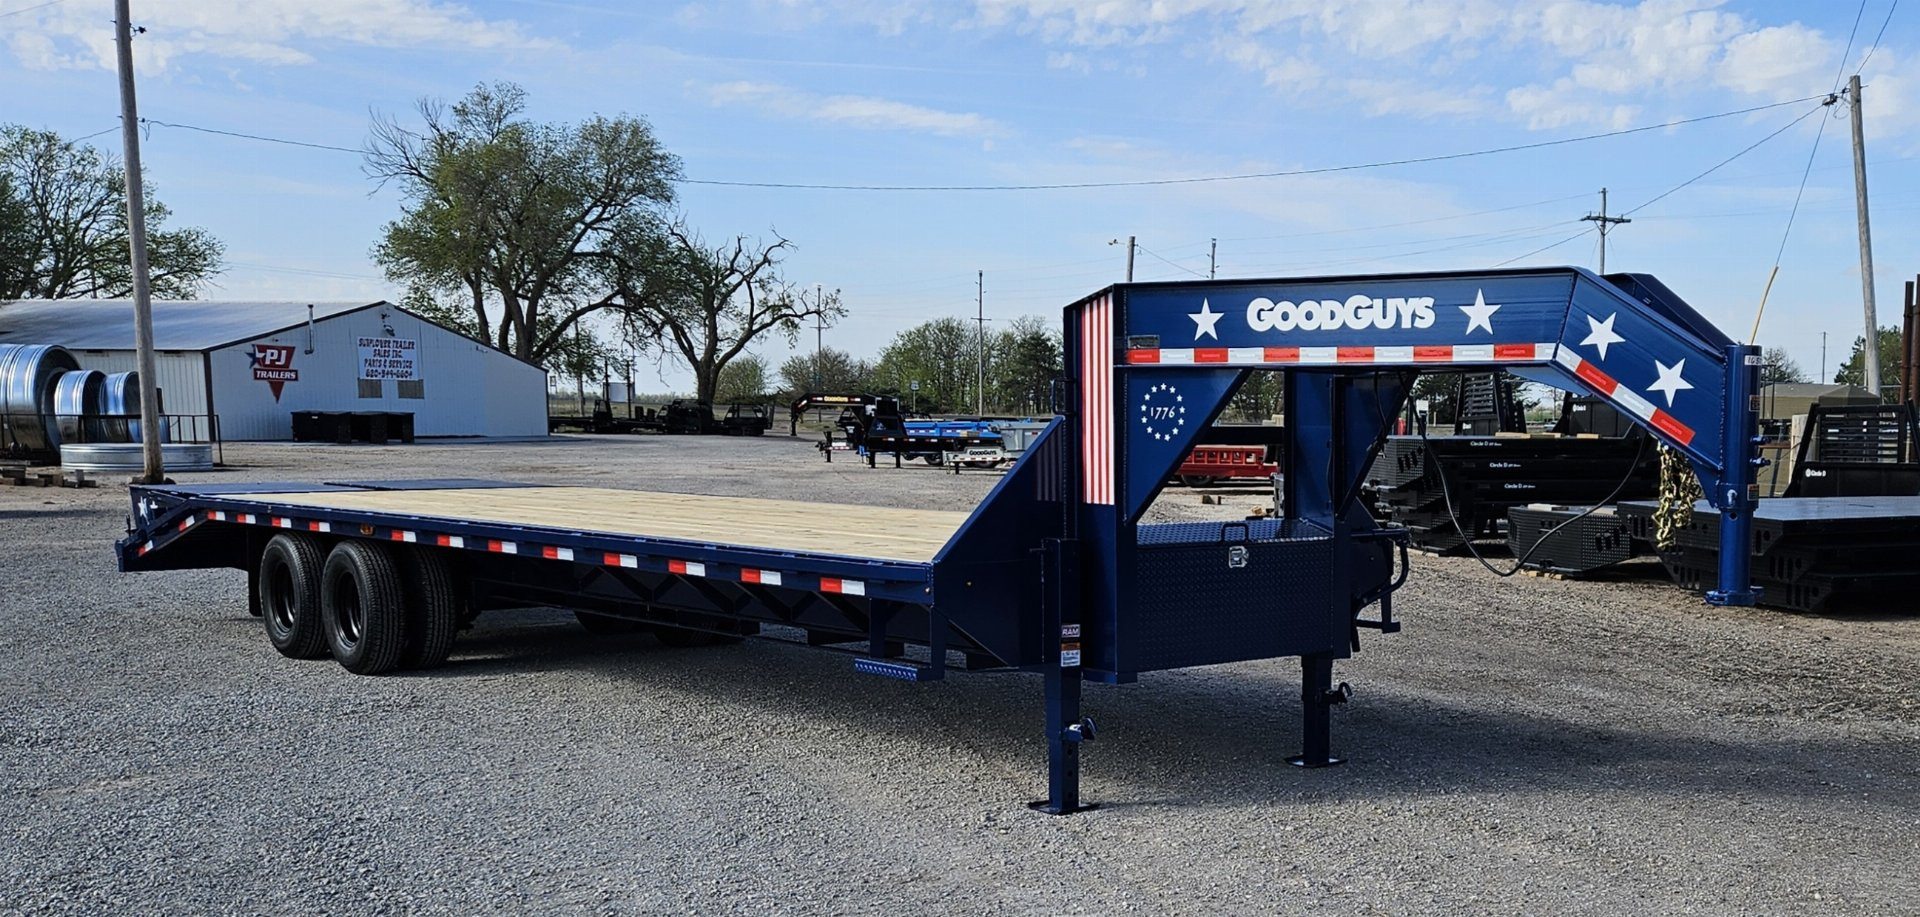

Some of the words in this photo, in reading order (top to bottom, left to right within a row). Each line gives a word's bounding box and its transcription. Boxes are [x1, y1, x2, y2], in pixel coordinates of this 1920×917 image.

[1247, 294, 1436, 332] GOODGUYS
[392, 340, 415, 349] TRAILER
[265, 349, 287, 365] PJ
[373, 348, 390, 358] SALES
[364, 358, 382, 368] PARTS
[389, 360, 413, 369] SERVICE
[256, 370, 297, 379] TRAILERS
[1150, 406, 1176, 420] 1776
[1062, 628, 1079, 636] RAM
